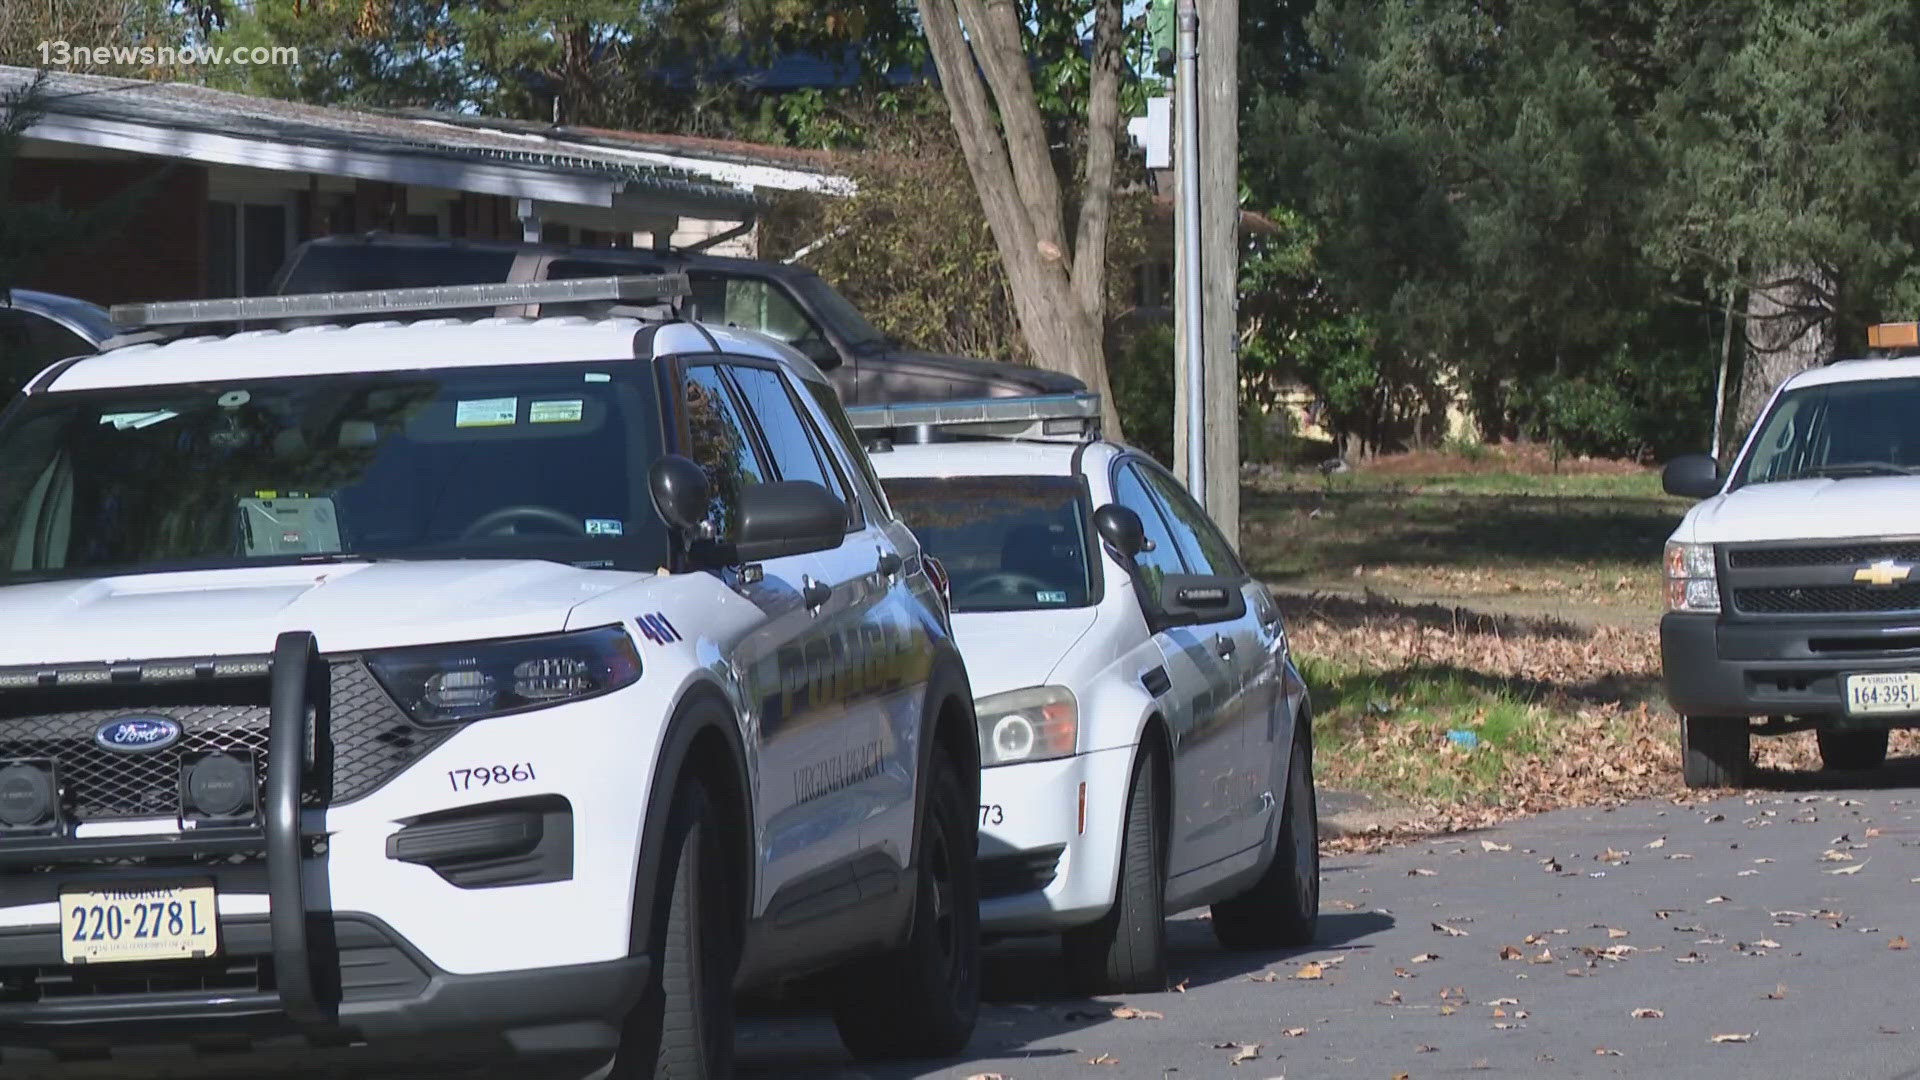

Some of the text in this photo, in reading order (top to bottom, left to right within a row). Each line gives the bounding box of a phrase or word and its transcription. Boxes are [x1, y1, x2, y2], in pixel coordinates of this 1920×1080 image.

[1867, 676, 1904, 685] VIRGINIA
[114, 722, 158, 743] Ford
[448, 762, 535, 792] 179861
[793, 740, 885, 806] VIRGINIA BEACH
[102, 887, 173, 901] VIRGINIA
